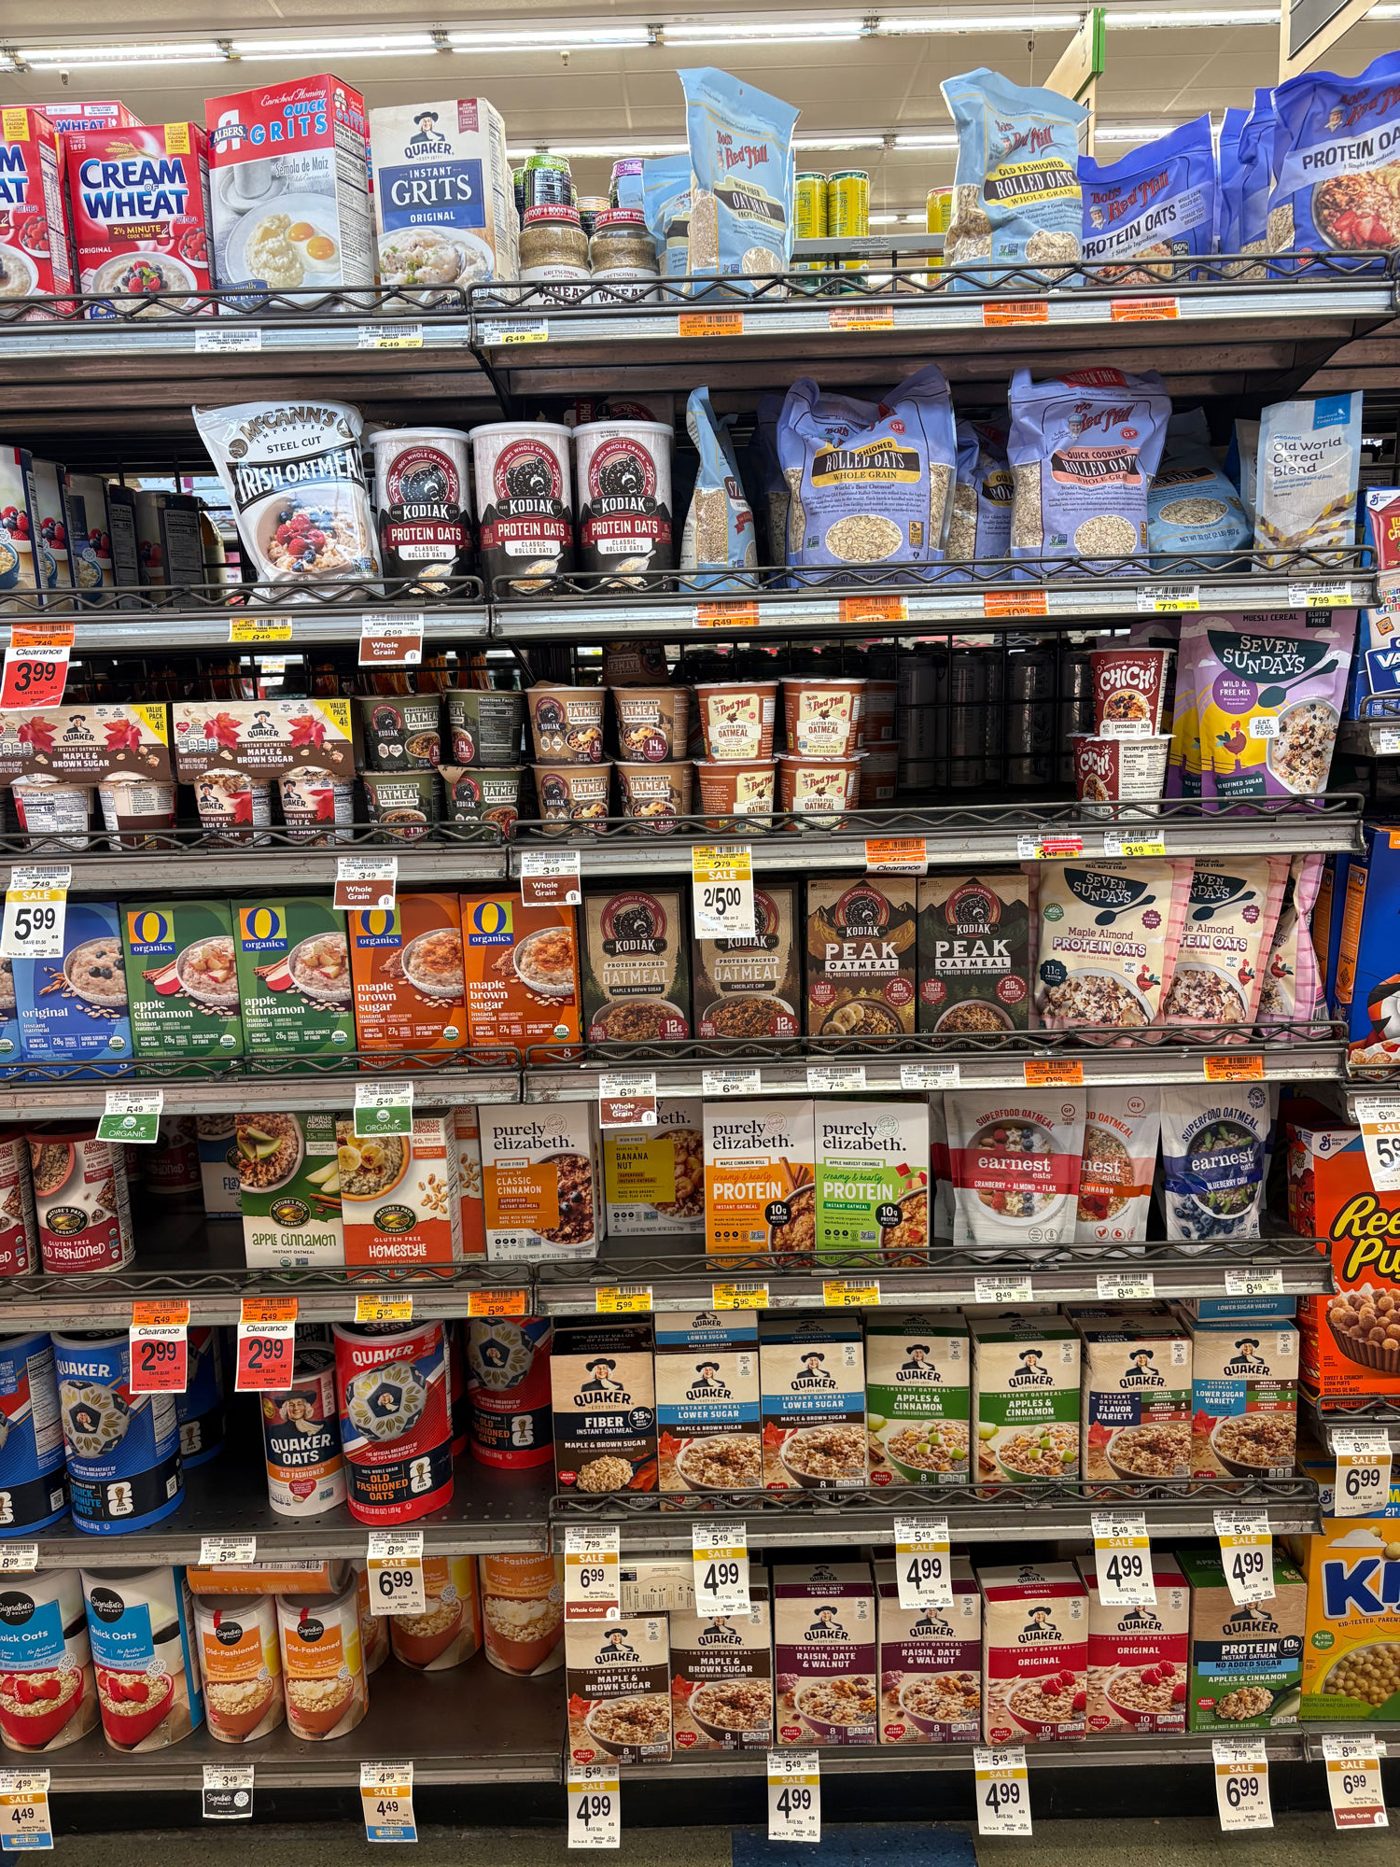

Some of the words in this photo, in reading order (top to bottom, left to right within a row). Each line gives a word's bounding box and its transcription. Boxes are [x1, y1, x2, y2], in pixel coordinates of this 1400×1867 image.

[283, 99, 326, 117] QUICK
[213, 125, 245, 142] ALBERS
[250, 114, 328, 144] GRITS
[70, 143, 86, 151] 1893
[404, 142, 451, 159] QUAKER
[1303, 138, 1374, 170] PROTEIN
[80, 157, 186, 189] CREAM
[409, 166, 452, 178] INSTANT
[999, 166, 1015, 176] OLD
[1017, 160, 1064, 176] FASHIONED
[145, 183, 159, 191] OF
[391, 174, 472, 206] GRITS
[996, 173, 1043, 199] ROLLED
[1047, 170, 1078, 189] OATS
[83, 190, 188, 219] WHEAT
[410, 212, 456, 223] ORIGINAL
[1145, 204, 1177, 231] OATS
[127, 225, 161, 233] MINUTE
[267, 441, 300, 454] STEEL
[301, 436, 322, 448] CUT
[1274, 442, 1297, 452] Old
[1300, 437, 1341, 451] World
[1067, 450, 1090, 460] QUICK
[1092, 448, 1127, 460] COOKING
[1274, 451, 1323, 464] Cereal
[825, 451, 869, 473] ROLLED
[875, 451, 905, 469] OATS
[833, 471, 865, 481] WHOLE
[868, 471, 897, 480] GRAIN
[1274, 463, 1317, 477] Blend
[236, 466, 283, 503] IRISH
[601, 497, 646, 513] KODIAK
[403, 503, 449, 520] KODIAK
[392, 527, 434, 542] PROTEIN
[437, 526, 461, 540] OATS
[592, 521, 632, 536] PROTEIN
[635, 520, 658, 535] OATS
[1243, 614, 1269, 622] MUESLI
[1270, 613, 1298, 621] CEREAL
[371, 641, 399, 649] Whole
[1240, 636, 1298, 654] SEVEN
[16, 647, 63, 656] Clearance
[1223, 648, 1304, 675] SUNDAYS
[146, 706, 162, 714] VALUE
[149, 713, 163, 721] PACK
[62, 733, 95, 743] QUAKER
[718, 729, 748, 737] OATMEAL
[708, 870, 736, 879] SALE
[22, 891, 51, 900] SALE
[1068, 927, 1096, 939] Maple
[1097, 928, 1133, 940] Almond
[133, 944, 173, 954] organics
[615, 940, 655, 952] KODIAK
[825, 942, 900, 959] PEAK
[1052, 937, 1111, 954] PROTEIN
[1113, 942, 1146, 957] OATS
[829, 961, 895, 970] OATMEAL
[714, 966, 782, 980] OATMEAL
[357, 982, 394, 993] maple
[358, 991, 397, 1001] brown
[133, 1000, 165, 1012] apple
[358, 1002, 392, 1013] sugar
[22, 1007, 69, 1019] original
[134, 1009, 193, 1019] cinnamon
[976, 1108, 1020, 1127] SUPERFOOD
[1021, 1109, 1056, 1131] OATMEAL
[108, 1129, 146, 1138] ORGANIC
[493, 1122, 546, 1138] purely
[493, 1135, 575, 1150] elizabeth.
[616, 1152, 649, 1161] BANANA
[978, 1154, 1051, 1171] earnest
[617, 1162, 632, 1170] NUT
[496, 1177, 532, 1186] CLASSIC
[497, 1186, 542, 1195] CINNAMON
[713, 1182, 782, 1200] PROTEIN
[138, 1328, 180, 1336] Clearance
[351, 1345, 413, 1366] QUAKER
[896, 1368, 941, 1382] QUAKER
[574, 1391, 631, 1407] QUAKER
[896, 1394, 932, 1402] APPLES
[933, 1394, 940, 1402] &
[894, 1402, 943, 1411] CINNAMON
[1099, 1405, 1132, 1413] FLAVOR
[632, 1411, 651, 1420] 35%
[710, 1410, 739, 1418] SUGAR
[584, 1417, 624, 1428] FIBER
[270, 1433, 331, 1453] QUAKER
[282, 1450, 319, 1466] OATS
[1351, 1456, 1378, 1465] SALE
[370, 1474, 390, 1483] OLD
[356, 1479, 409, 1491] FASHIONED
[369, 1491, 394, 1500] OATS
[380, 1559, 407, 1567] SALE
[1325, 1559, 1400, 1617] KI
[91, 1595, 124, 1617] Signature
[91, 1625, 111, 1641] Quick
[112, 1631, 137, 1641] Oats
[1222, 1621, 1279, 1635] QUAKER
[804, 1629, 848, 1641] QUAKER
[206, 1641, 260, 1657] Old-Fashioned
[1221, 1643, 1278, 1655] PROTEIN
[796, 1652, 830, 1661] RAISIN,
[832, 1652, 856, 1660] DATE
[1018, 1657, 1060, 1666] ORIGINAL
[802, 1660, 809, 1668] &
[810, 1660, 850, 1668] WALNUT
[597, 1675, 629, 1683] MAPLE
[631, 1674, 638, 1682] &
[585, 1682, 619, 1691] BROWN
[620, 1681, 651, 1690] SUGAR
